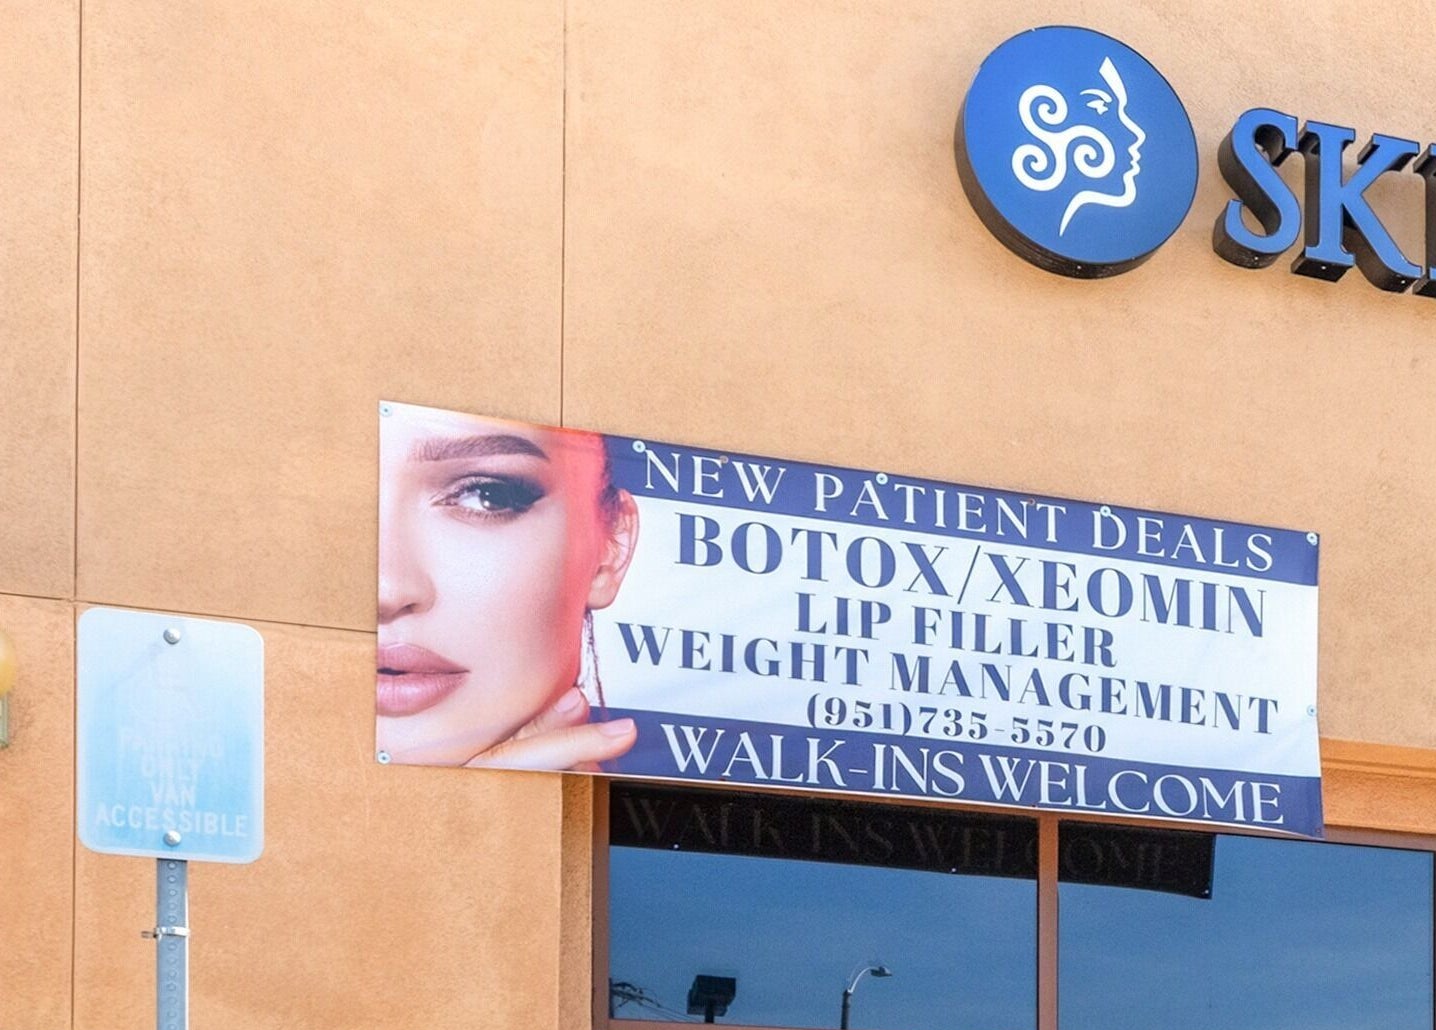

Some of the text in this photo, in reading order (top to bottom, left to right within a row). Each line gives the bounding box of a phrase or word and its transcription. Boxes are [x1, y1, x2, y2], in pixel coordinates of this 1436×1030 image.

[643, 447, 1275, 572] NEW PATIENT DEALS
[674, 511, 1268, 640] BOTOX/XEOMIN
[795, 590, 1119, 669] LIP FILLER
[616, 620, 1280, 736] WEIGHT MANAGEMENT
[805, 699, 1108, 754] (951)735-5570
[150, 782, 196, 807] VAN
[662, 724, 1284, 826] WALK-INS WELCOME
[95, 803, 248, 838] ACCESSIBLE
